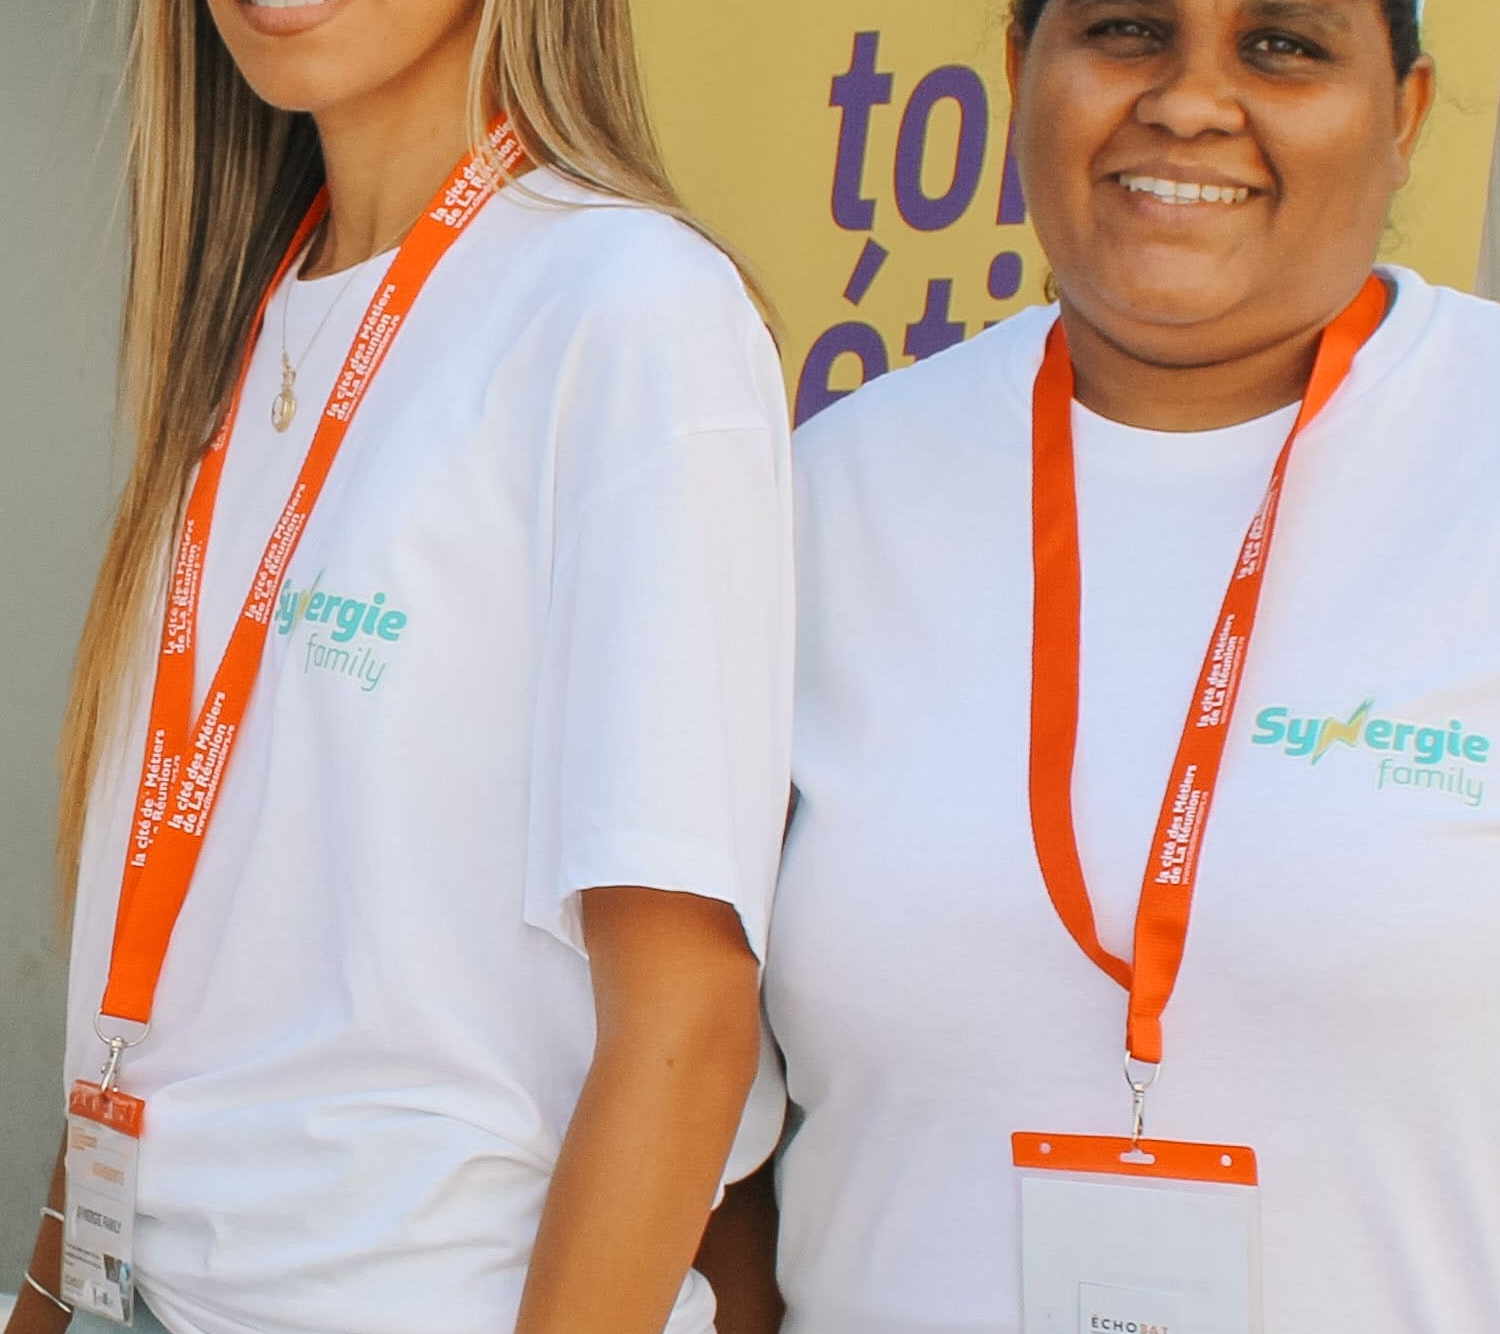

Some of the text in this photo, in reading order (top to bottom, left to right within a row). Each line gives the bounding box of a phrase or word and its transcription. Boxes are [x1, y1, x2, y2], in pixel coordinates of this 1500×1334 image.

[429, 208, 448, 222] la
[445, 178, 468, 206] cité
[444, 208, 462, 226] de
[456, 189, 477, 207] La
[326, 283, 396, 418] la cité des Métiers
[336, 313, 392, 421] de La Réunion
[179, 544, 198, 607] Réunion
[244, 483, 306, 619] la cité des Métiers
[254, 513, 300, 623] de La Réunion
[175, 634, 185, 654] de
[176, 610, 187, 630] La
[1212, 613, 1236, 662] Métiers
[163, 640, 176, 655] la
[305, 633, 386, 692] family
[1215, 635, 1238, 688] Réunion
[1206, 663, 1222, 686] des
[1212, 689, 1226, 707] La
[1196, 714, 1209, 728] la
[1201, 687, 1216, 712] cité
[1208, 709, 1221, 727] de
[144, 729, 166, 788] Métiers
[167, 691, 227, 830] la cité des Métiers
[182, 723, 228, 834] de La Réunion
[1377, 759, 1484, 807] family
[151, 757, 173, 821] Réunion
[135, 819, 152, 850] cité
[1155, 764, 1198, 884] la cité des Métiers
[1169, 789, 1201, 885] de La Réunion
[130, 852, 147, 867] la
